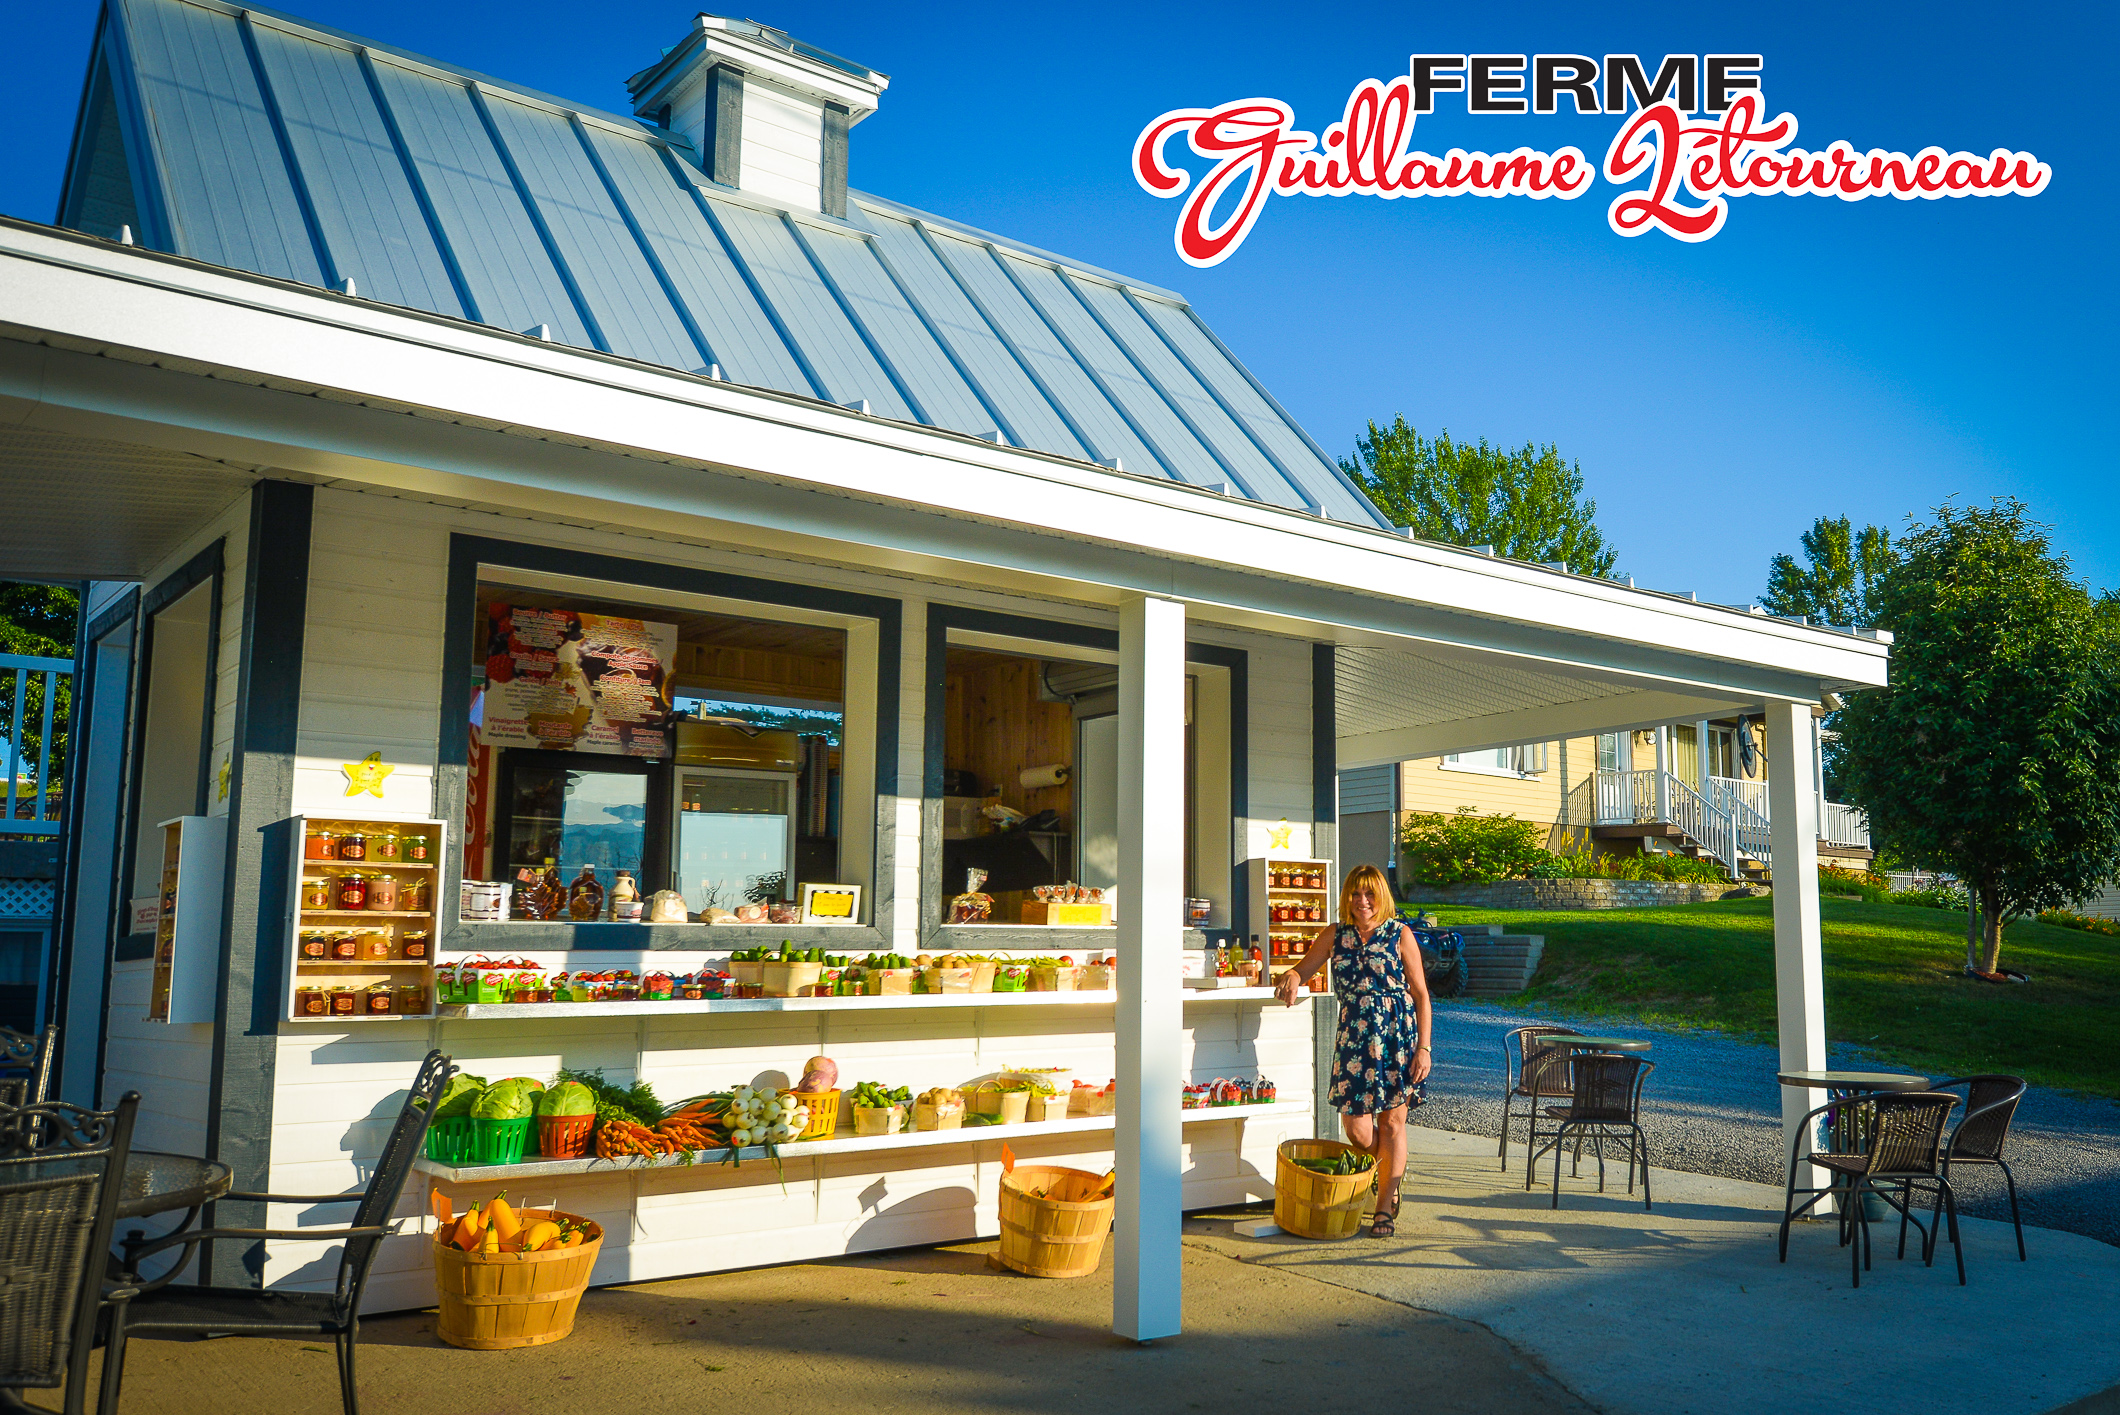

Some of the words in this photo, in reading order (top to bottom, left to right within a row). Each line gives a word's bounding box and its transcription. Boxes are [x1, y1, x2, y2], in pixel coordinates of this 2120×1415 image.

[606, 619, 623, 628] Tarte
[539, 654, 560, 664] Sauce
[592, 650, 620, 660] Compote
[631, 655, 658, 664] pommes
[608, 660, 627, 668] Apple
[629, 662, 648, 670] Sauce
[600, 674, 631, 683] Confiture
[638, 678, 651, 686] Jam
[488, 716, 528, 726] Vinaigrette
[539, 720, 573, 729] Moutarde
[591, 725, 619, 733] Caramel
